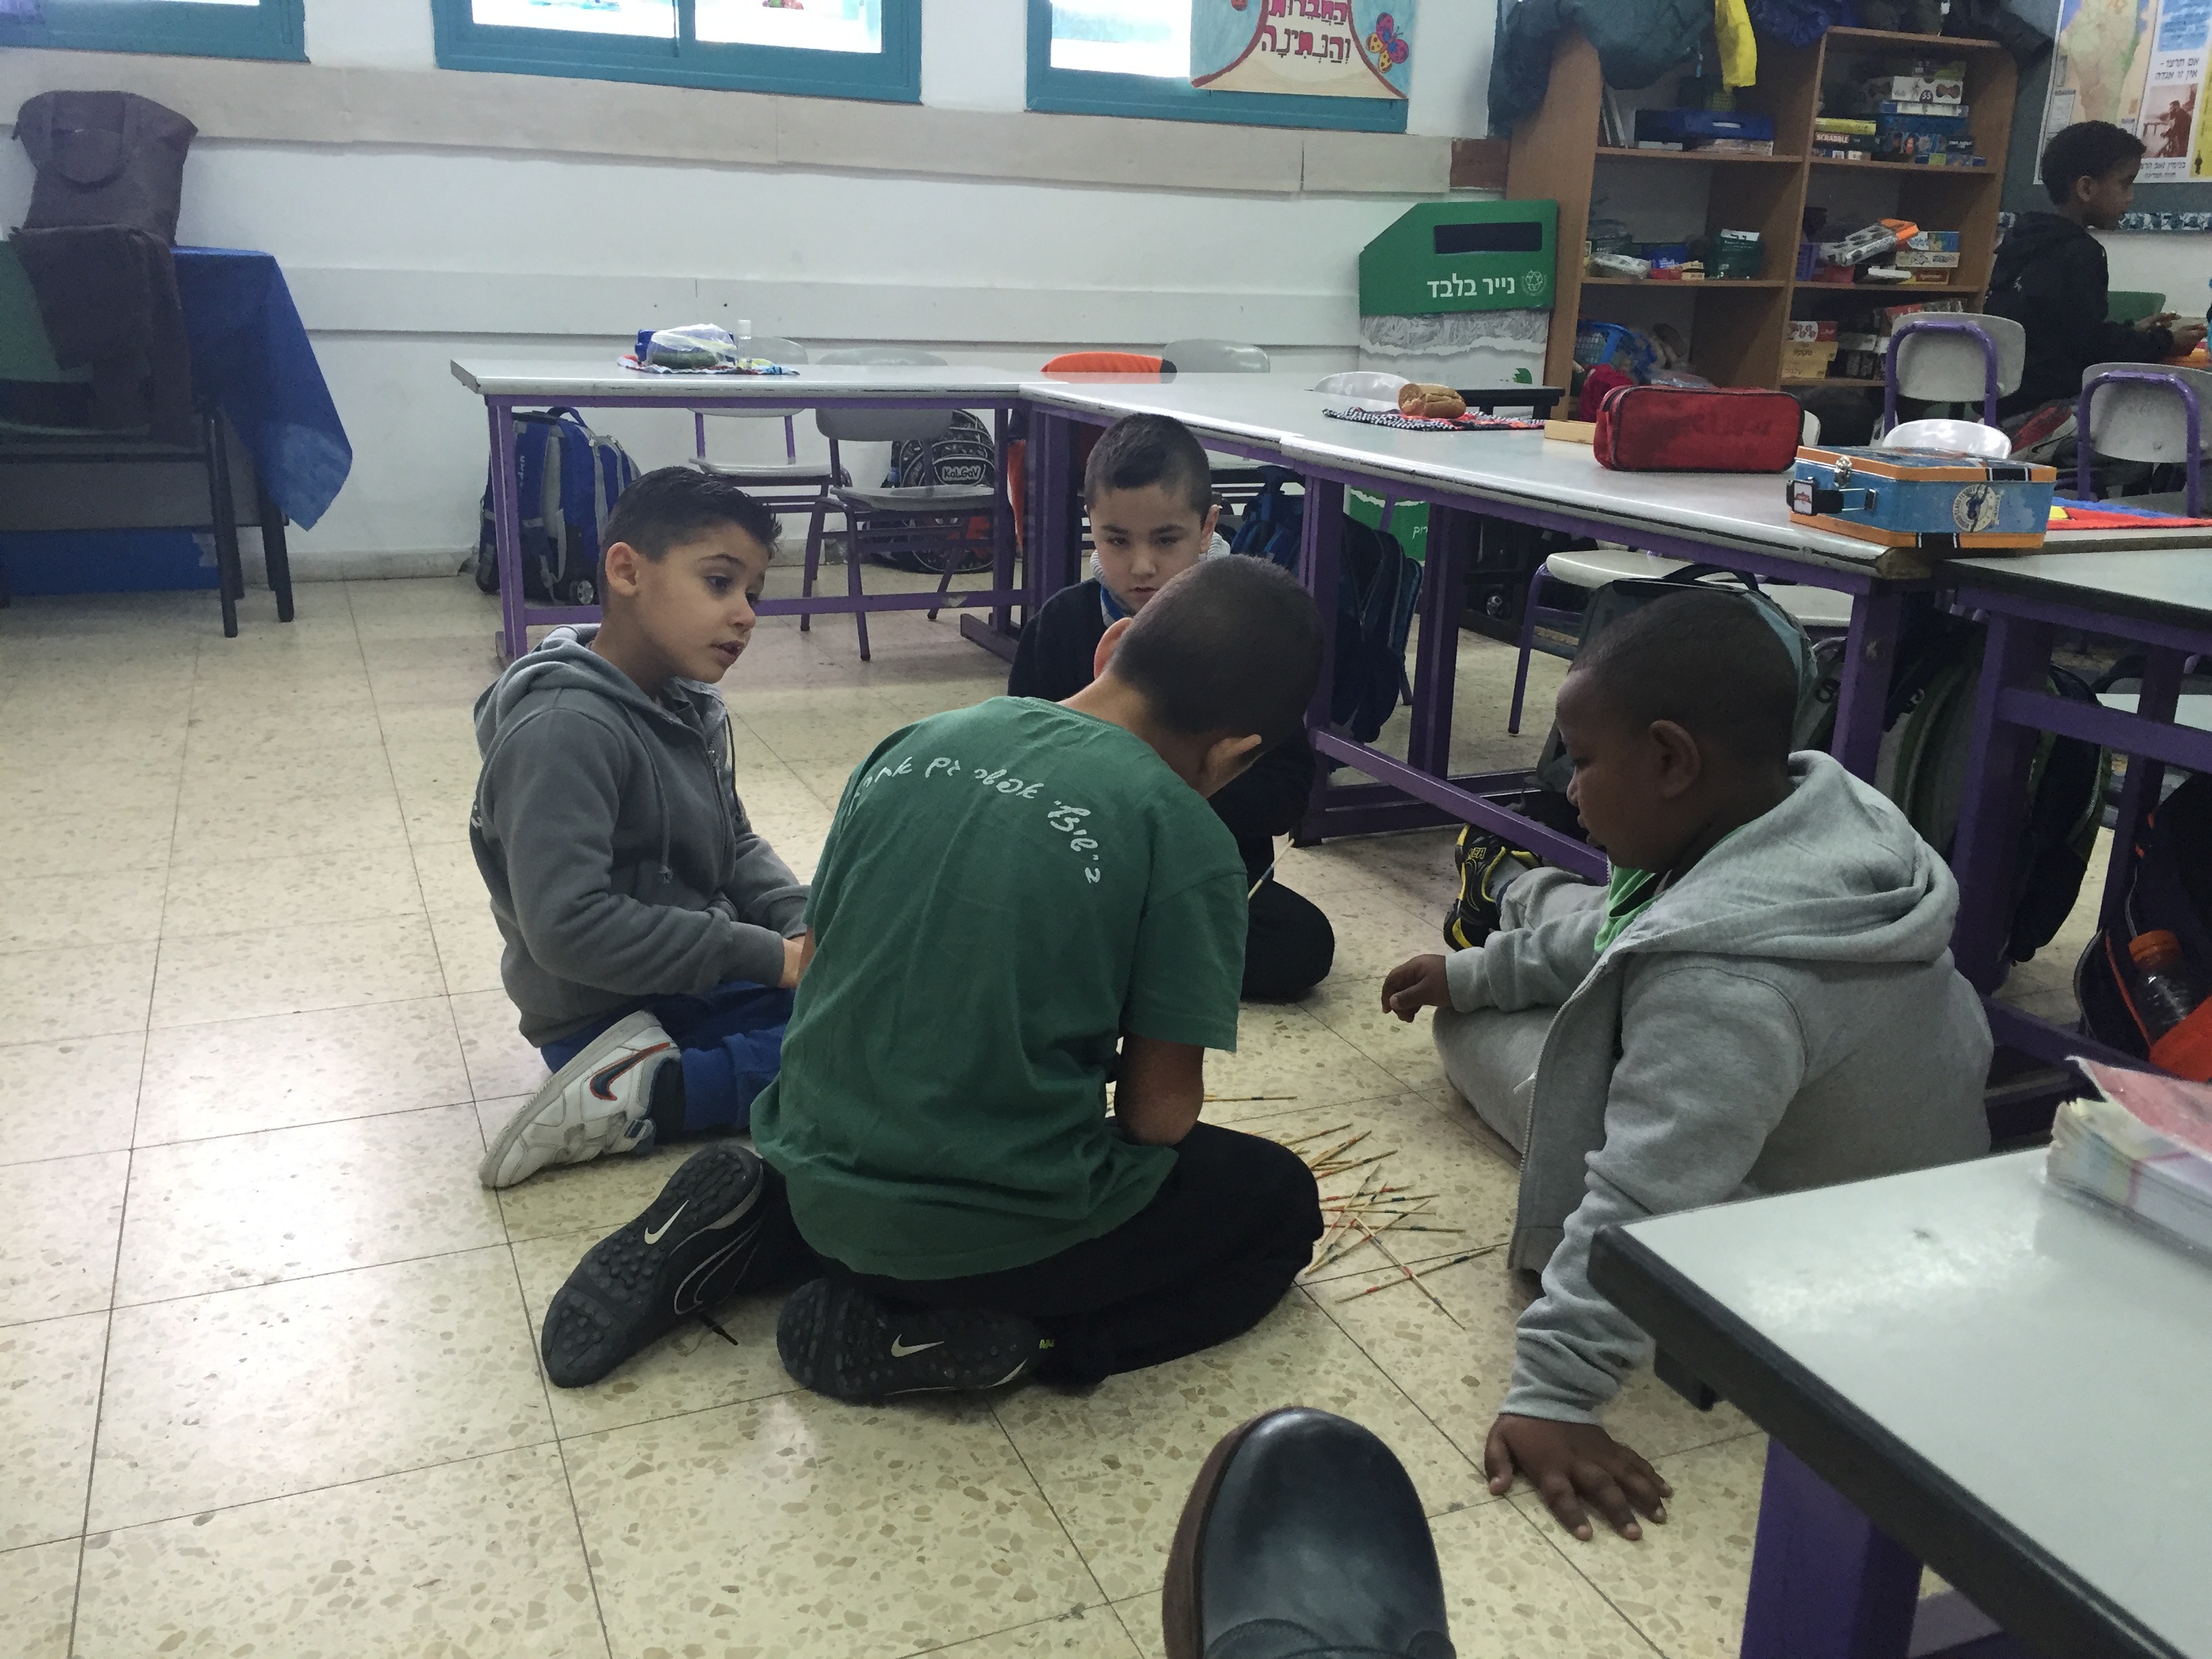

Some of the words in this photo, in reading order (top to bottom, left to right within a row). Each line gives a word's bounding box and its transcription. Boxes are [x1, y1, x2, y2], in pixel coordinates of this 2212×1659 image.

[1816, 133, 1849, 144] SCRABBLE
[1427, 272, 1477, 298] בלבד
[1483, 276, 1515, 295] נייר
[1412, 526, 1429, 540] רוק
[925, 757, 961, 778] גם
[975, 768, 1045, 800] אפשר
